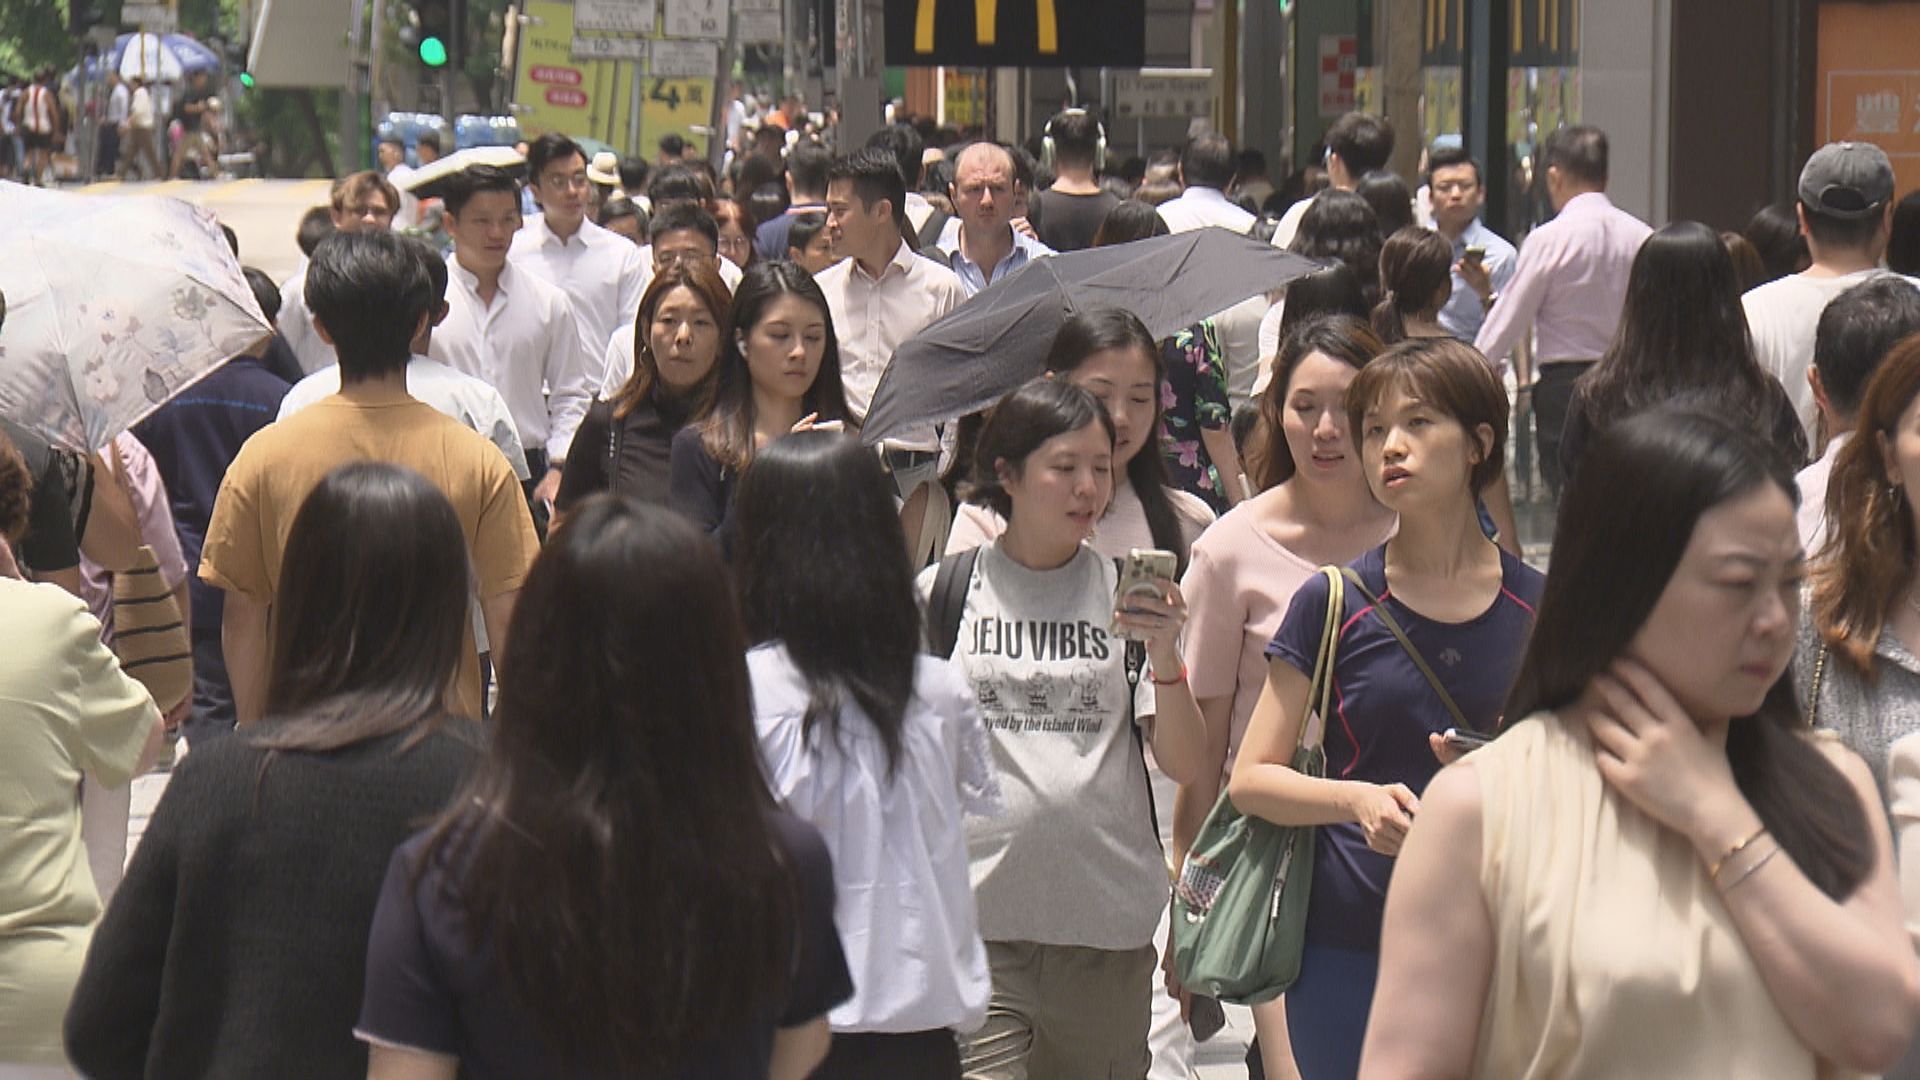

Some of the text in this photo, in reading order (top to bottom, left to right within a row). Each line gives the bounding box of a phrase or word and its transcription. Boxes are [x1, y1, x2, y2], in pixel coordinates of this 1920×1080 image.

[968, 616, 1109, 661] JEJU VIBES
[1009, 715, 1023, 732] by
[1024, 717, 1041, 731] the
[1042, 717, 1076, 732] Island
[1077, 717, 1103, 733] Wind
